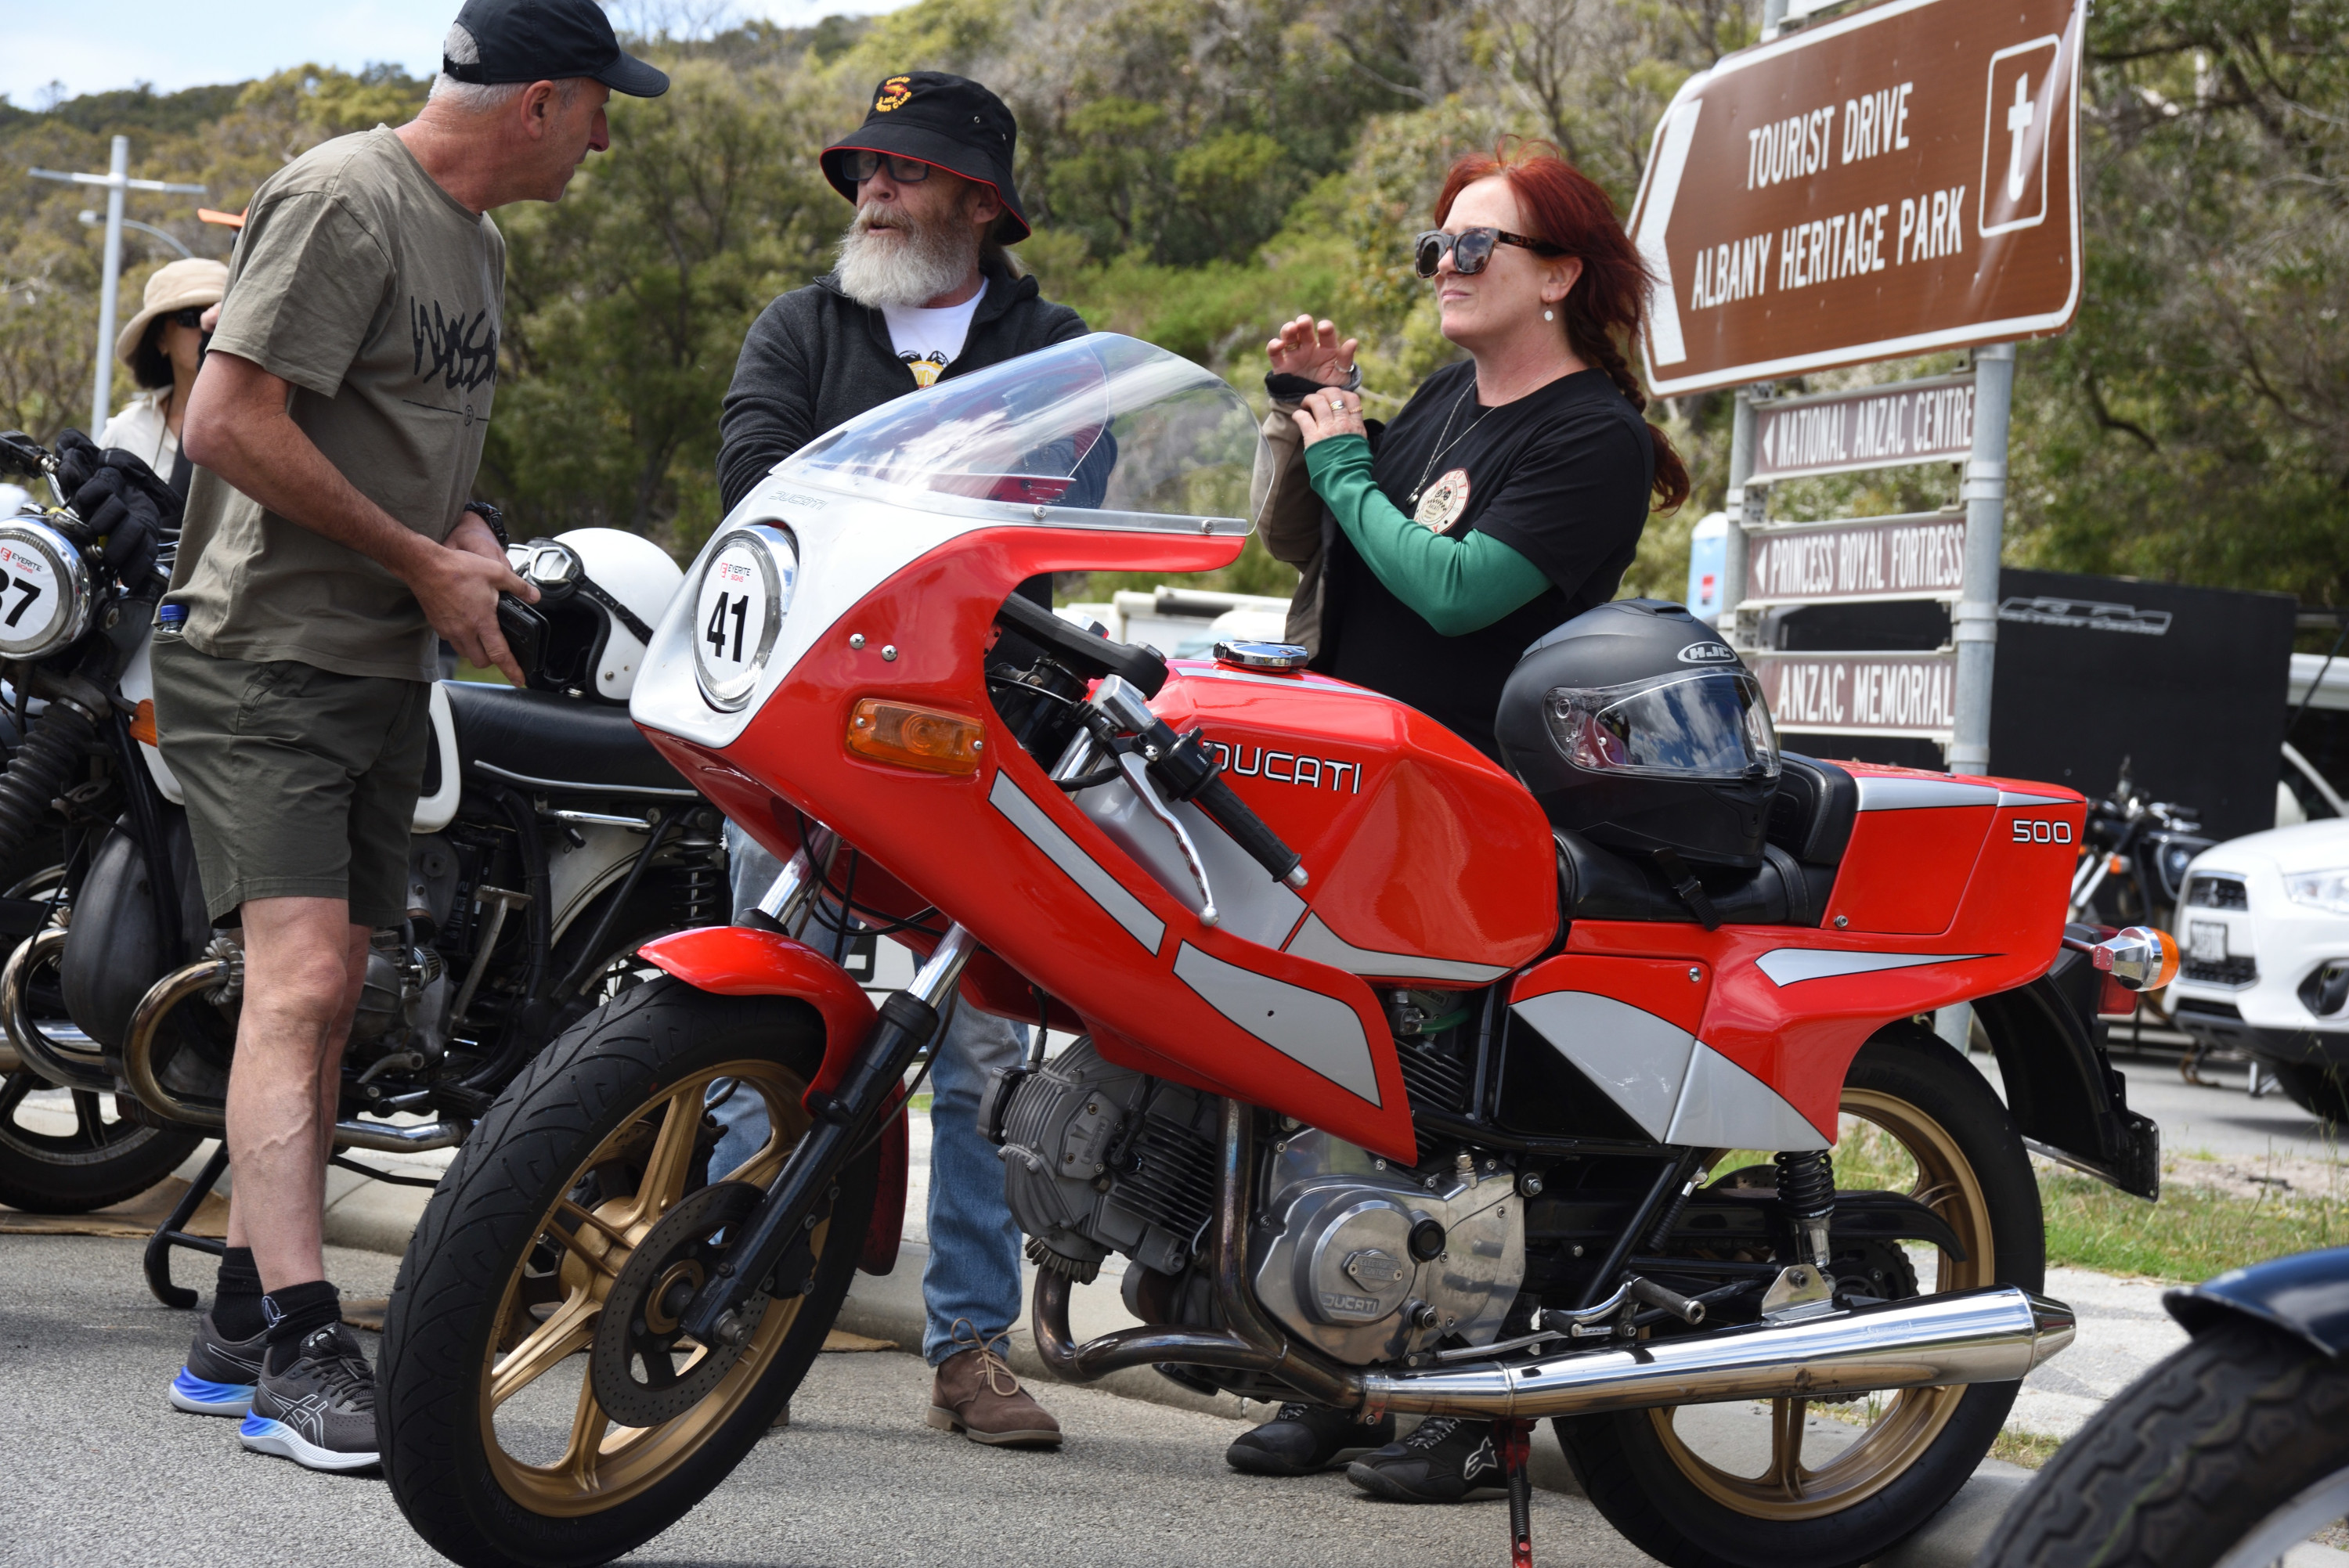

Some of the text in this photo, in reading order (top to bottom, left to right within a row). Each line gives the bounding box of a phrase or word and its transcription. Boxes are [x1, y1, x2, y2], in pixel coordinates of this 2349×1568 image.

[1747, 82, 1914, 190] TOURIST DRIVE
[1690, 185, 1966, 311] ALBANY HERITAGE PARK
[1777, 385, 1975, 468] NATIONAL ANZAC CENTRE
[768, 490, 829, 511] DUCATI
[12, 553, 42, 572] EYERITE
[16, 562, 34, 575] SIGNS
[727, 564, 752, 577] EYERITE
[1769, 523, 1965, 595] PRINCESS ROYAL FORTRESS
[730, 574, 745, 582] SIGNS
[706, 591, 749, 663] 41
[1688, 645, 1732, 660] HJC
[1777, 662, 1954, 726] ANZAC MEMORIAL
[1203, 740, 1362, 795] DUCATI
[2012, 818, 2073, 845] 500
[1322, 1295, 1378, 1312] DUCATI
